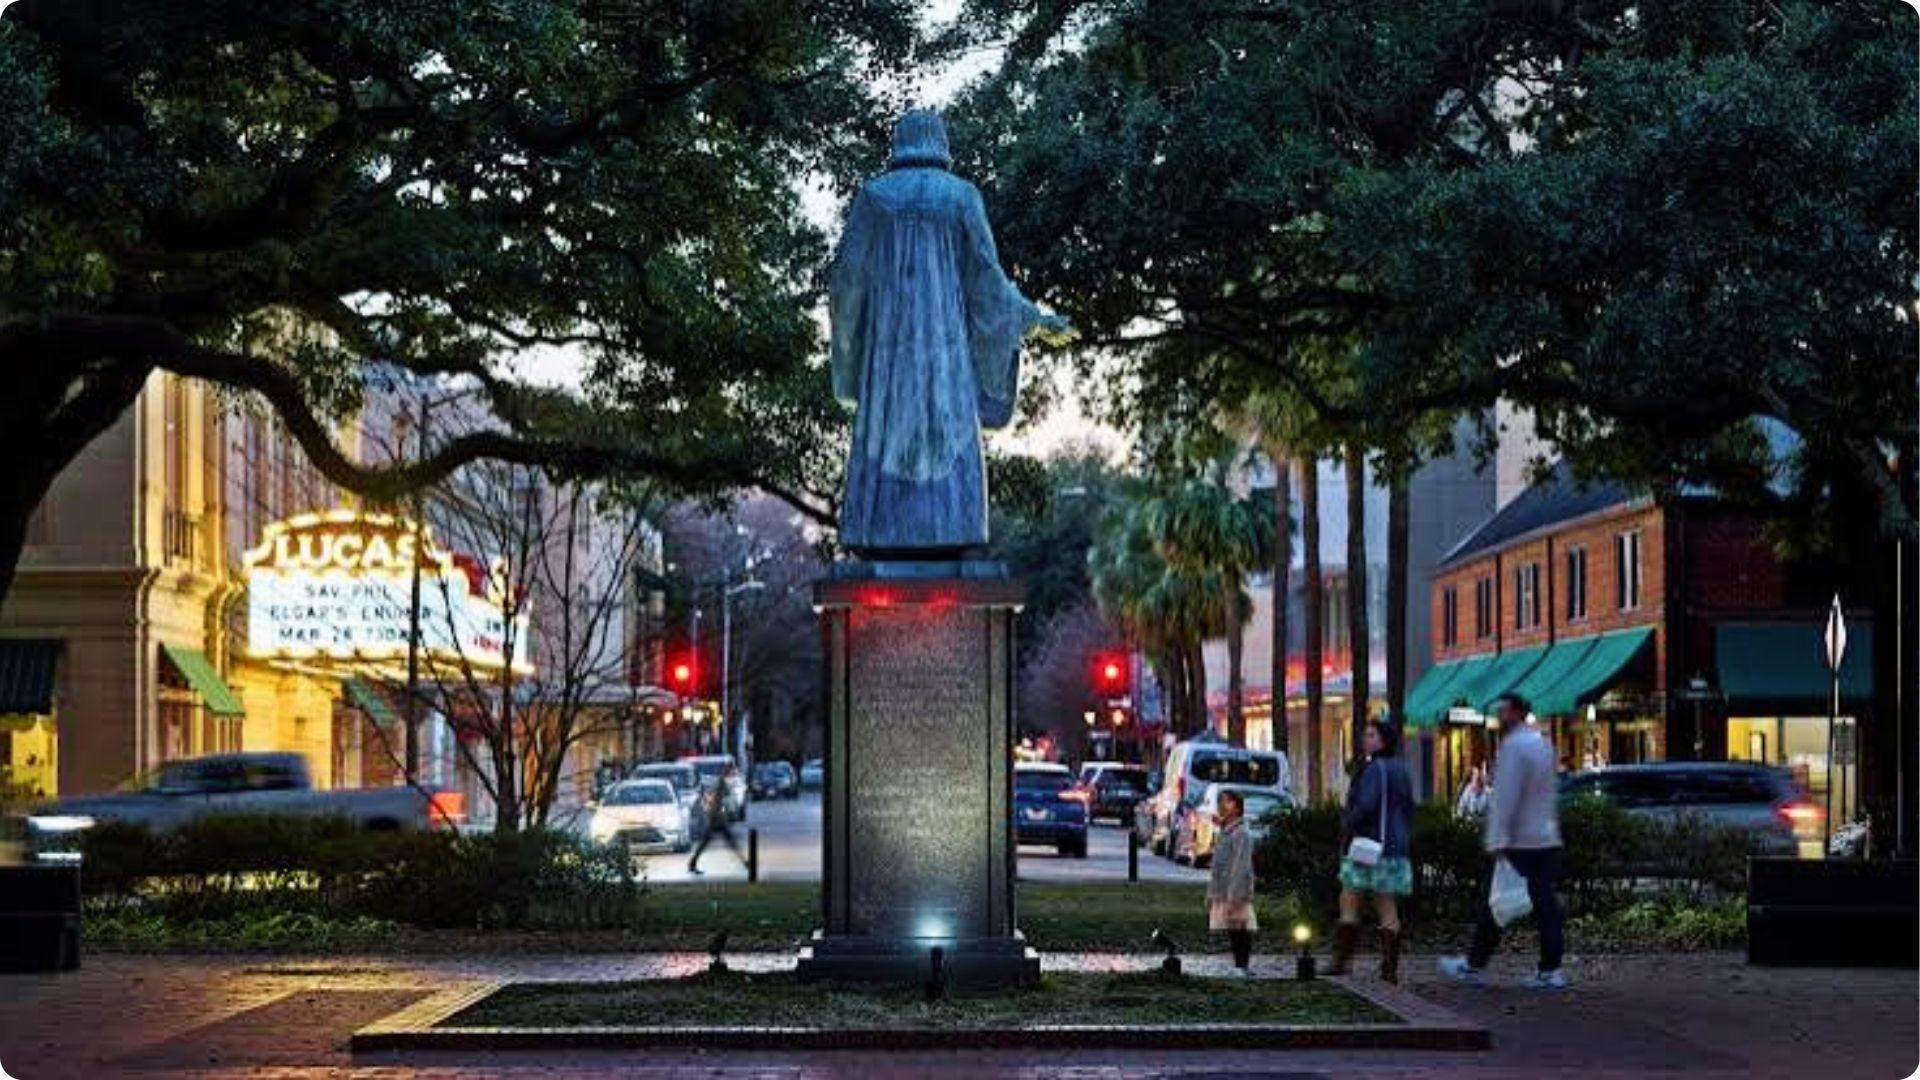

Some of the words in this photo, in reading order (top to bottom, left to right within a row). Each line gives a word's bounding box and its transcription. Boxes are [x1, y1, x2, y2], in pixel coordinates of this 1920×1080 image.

[275, 532, 416, 567] LUCAS
[305, 583, 340, 599] SAV
[361, 605, 431, 620] ENA
